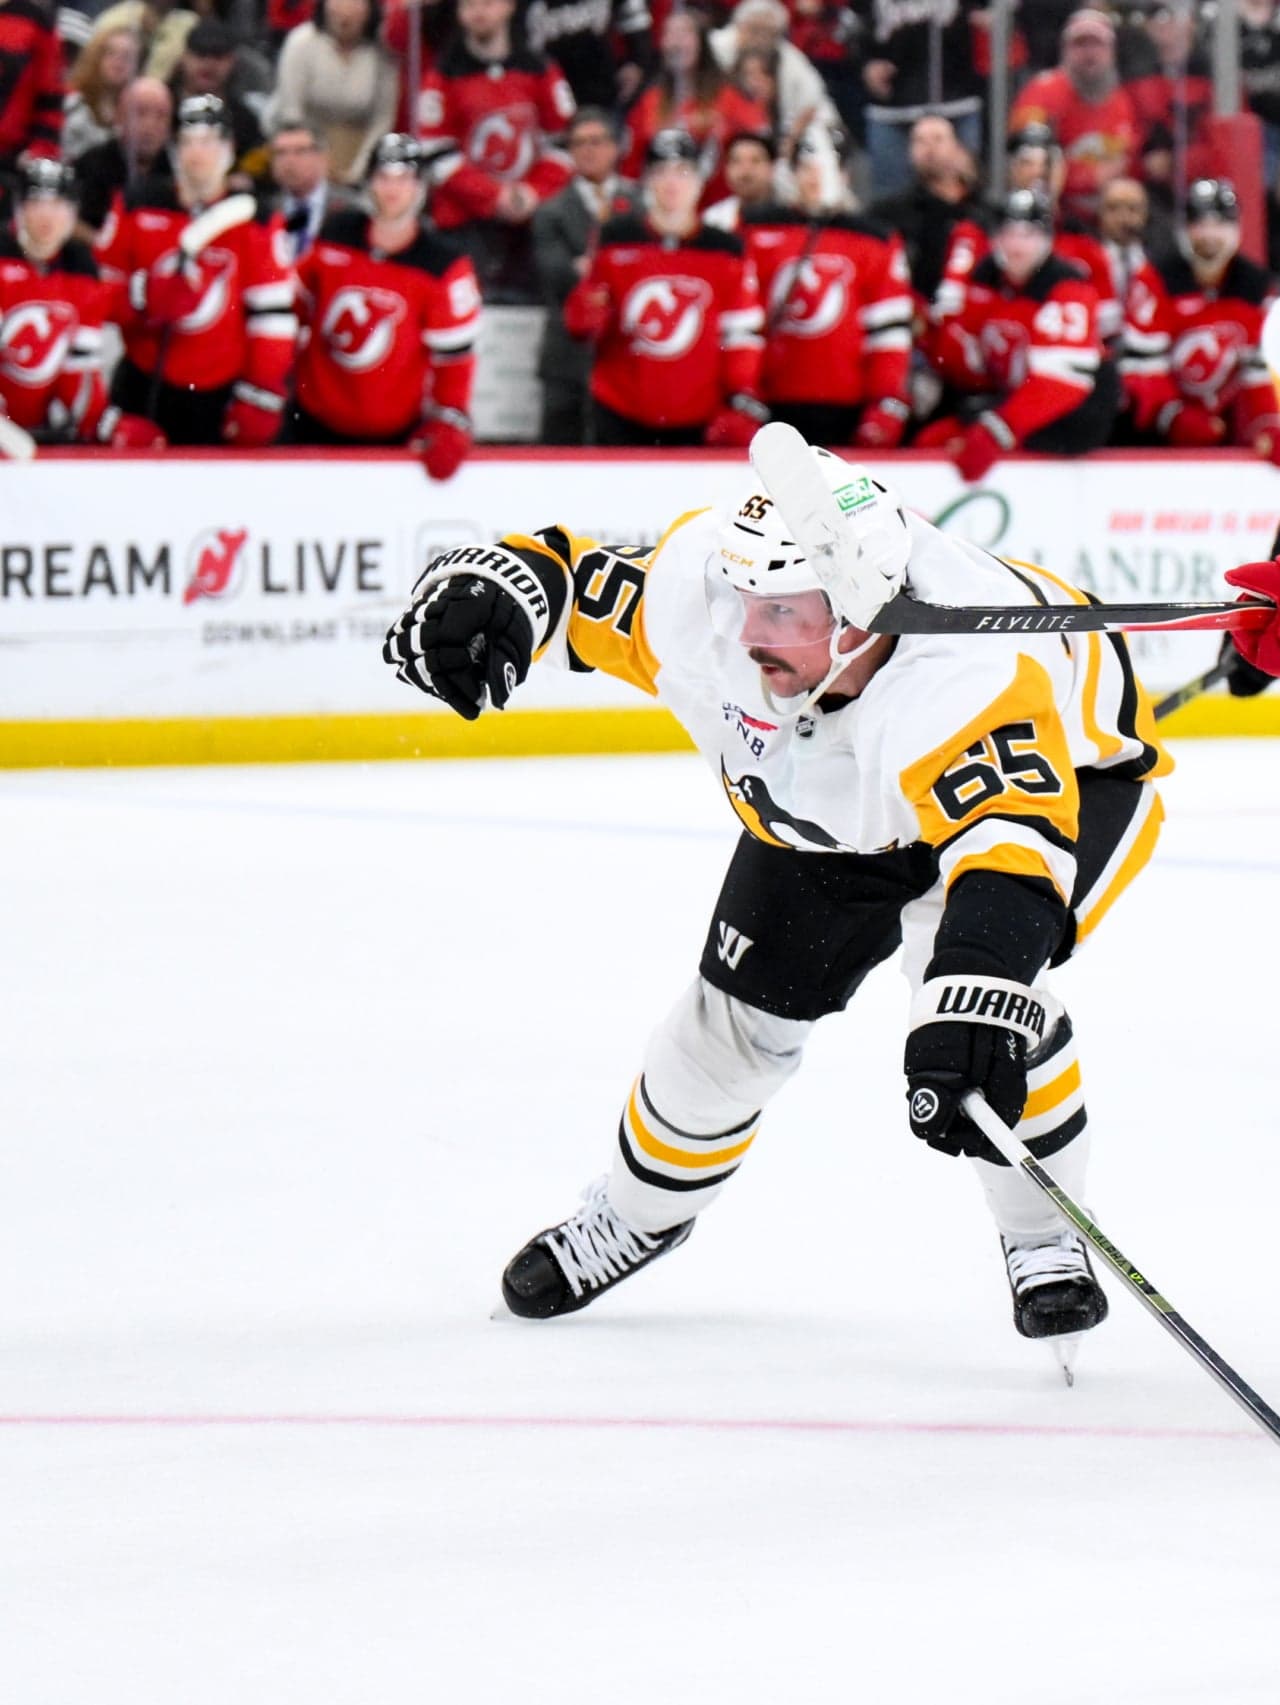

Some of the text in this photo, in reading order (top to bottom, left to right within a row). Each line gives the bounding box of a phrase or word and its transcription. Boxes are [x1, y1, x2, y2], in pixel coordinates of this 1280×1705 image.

[1034, 301, 1088, 341] 43
[738, 494, 774, 521] 65
[261, 541, 383, 594] LIVE
[976, 615, 1075, 631] FLYLITE
[932, 721, 1063, 821] 65
